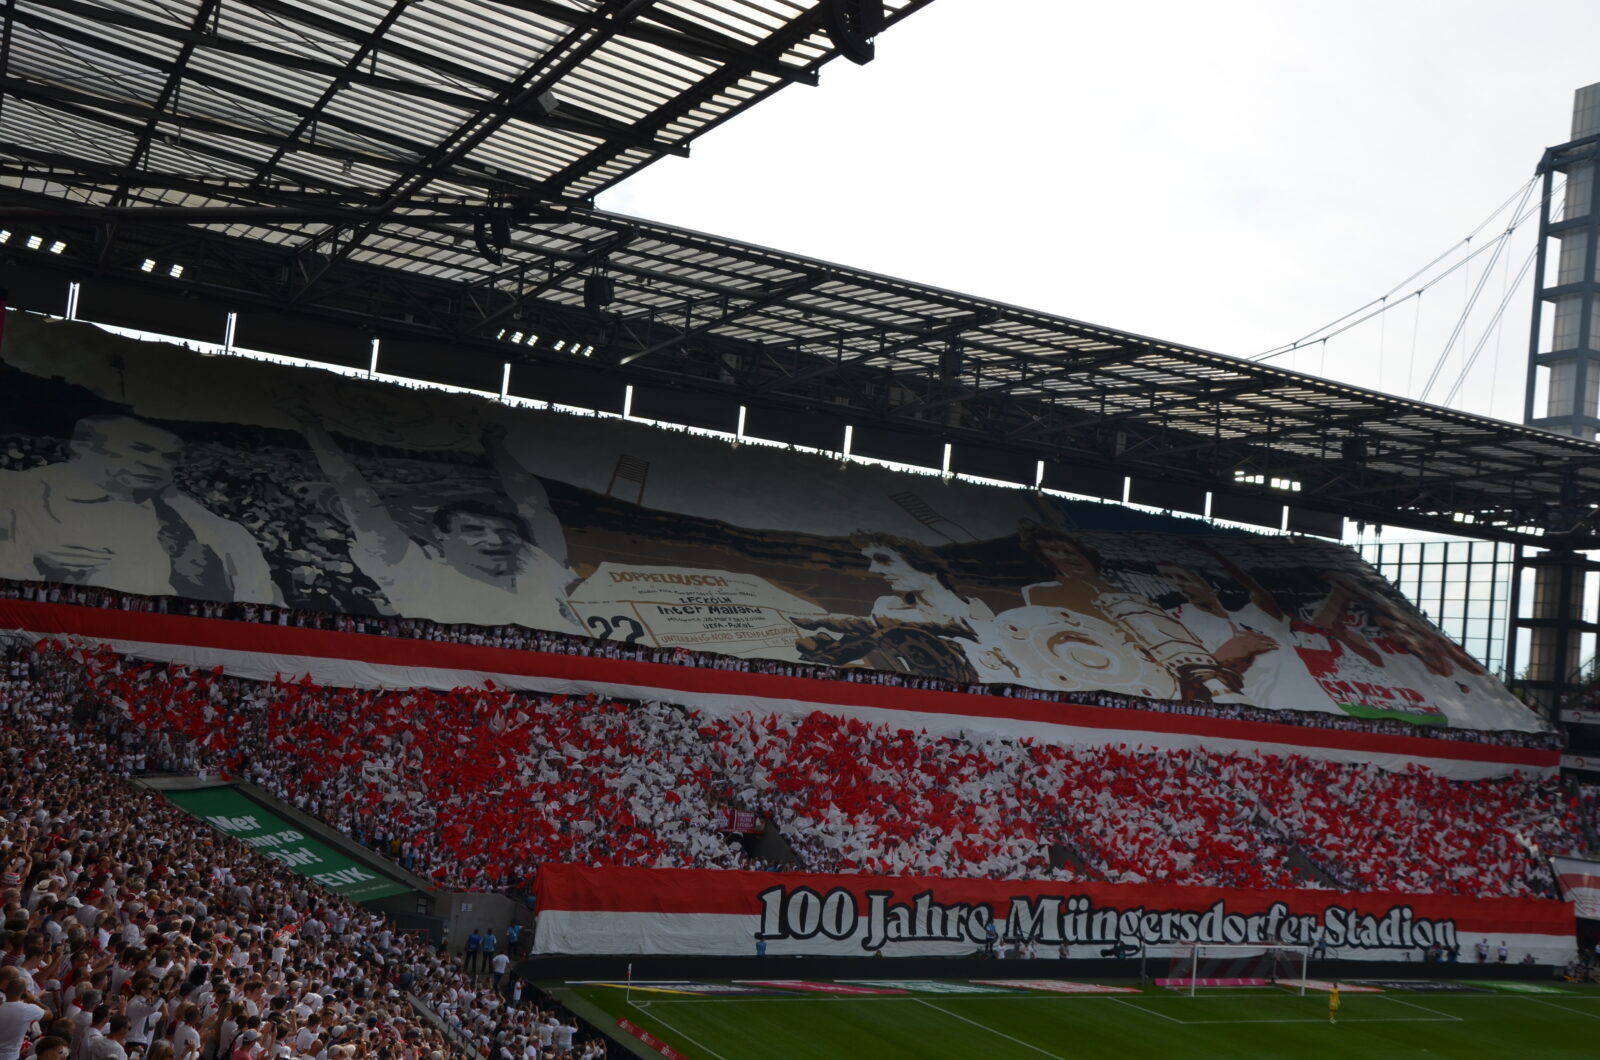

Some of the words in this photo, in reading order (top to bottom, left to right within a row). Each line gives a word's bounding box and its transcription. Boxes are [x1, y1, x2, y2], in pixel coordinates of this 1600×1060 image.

[657, 605, 704, 615] Inter
[708, 605, 762, 615] Mailand
[205, 815, 262, 832] Mer
[754, 884, 860, 941] 100
[860, 888, 998, 952] Jahre
[1003, 895, 1319, 960] Müngersdorfer
[1321, 904, 1461, 951] Stadion
